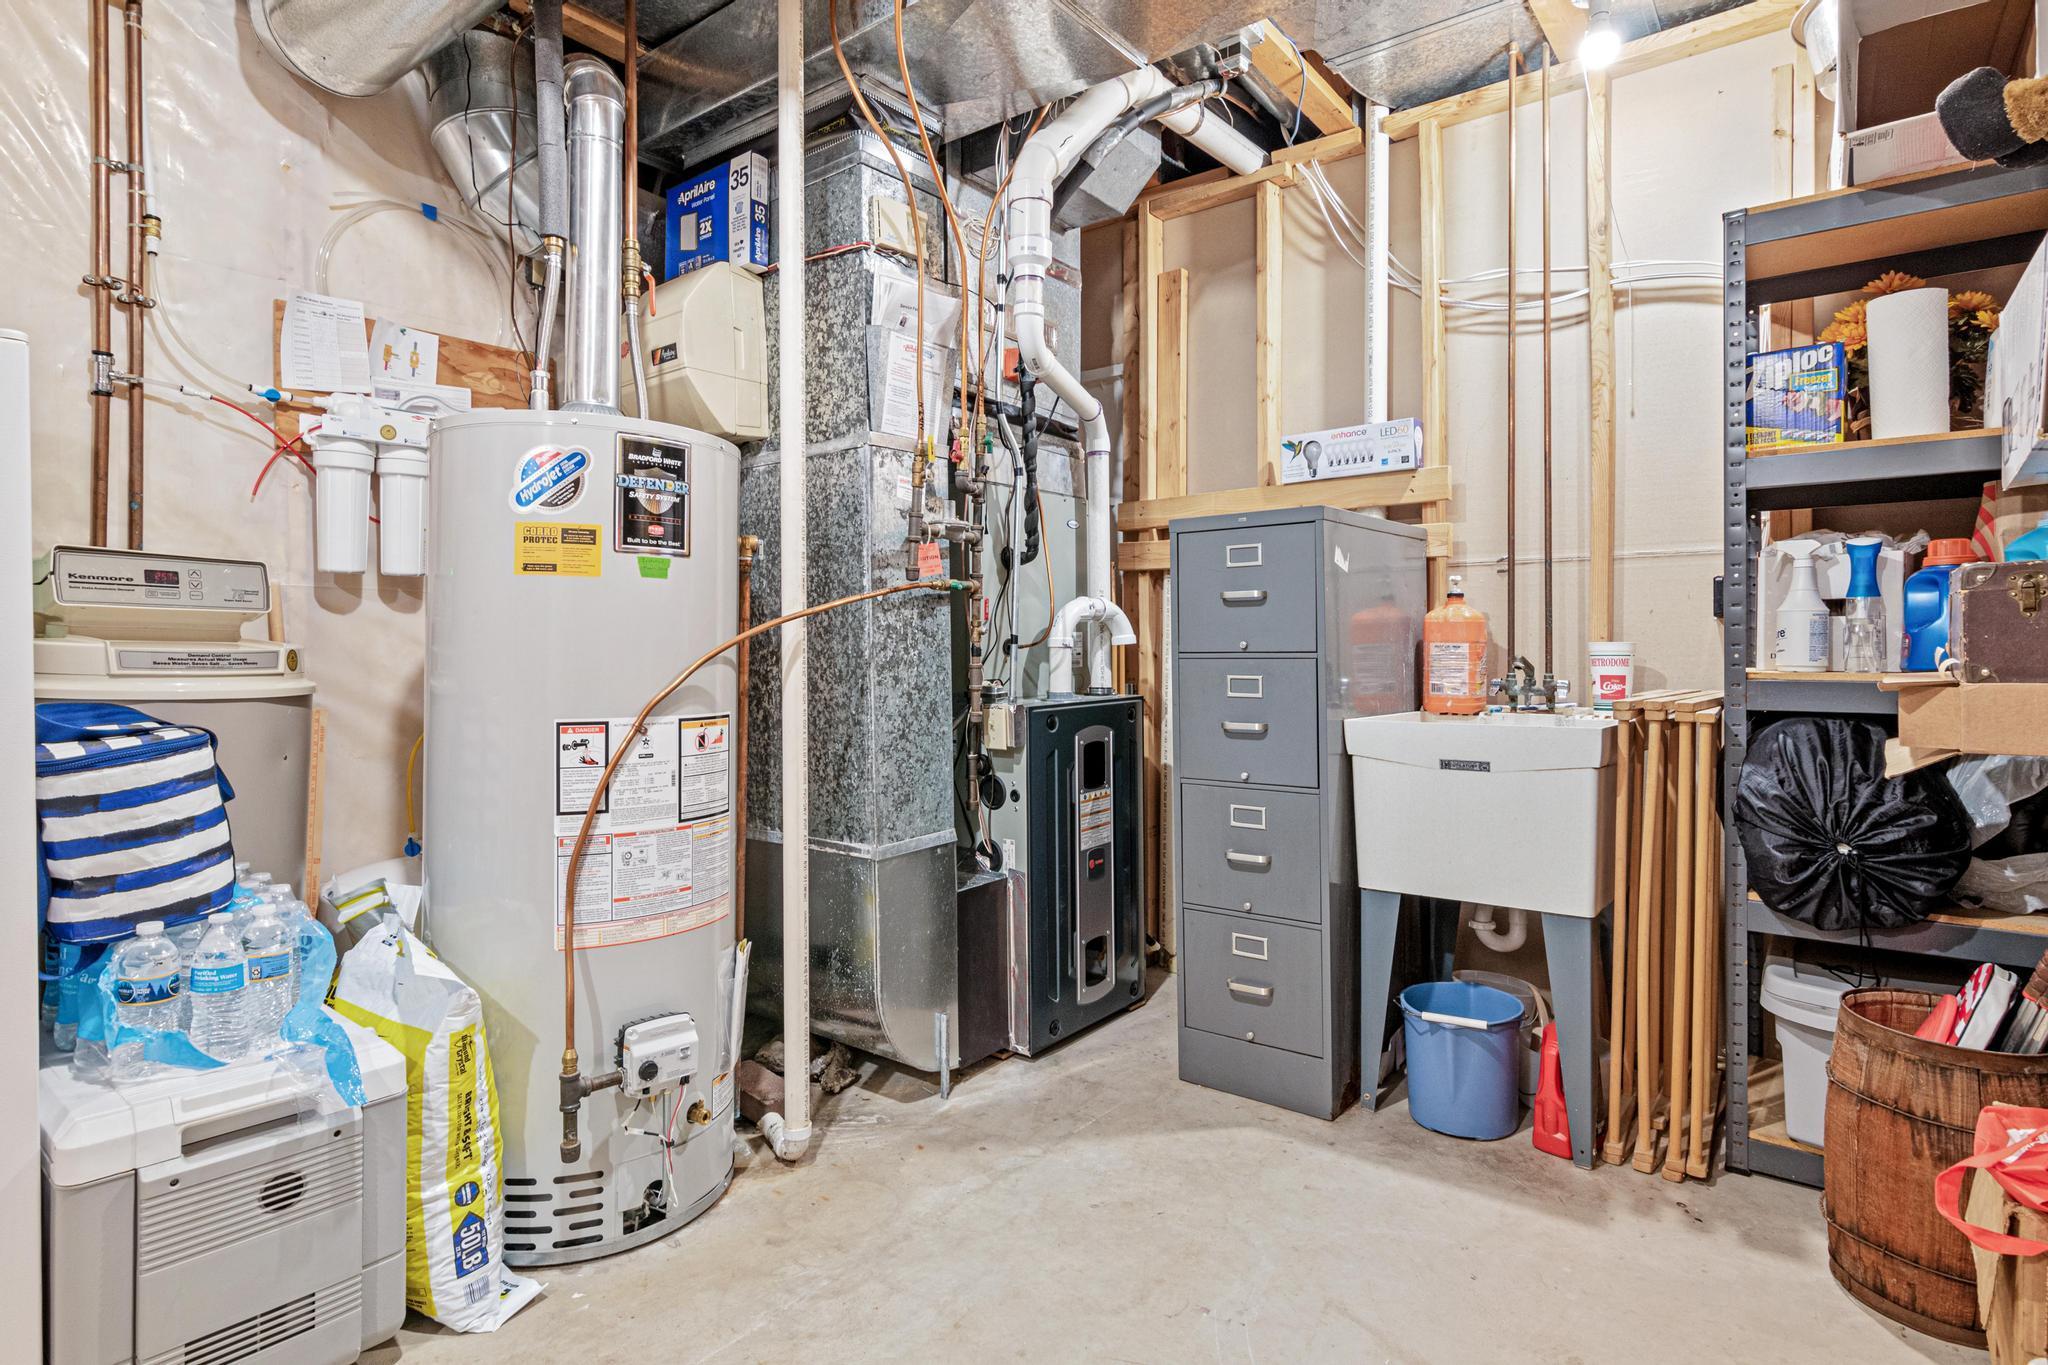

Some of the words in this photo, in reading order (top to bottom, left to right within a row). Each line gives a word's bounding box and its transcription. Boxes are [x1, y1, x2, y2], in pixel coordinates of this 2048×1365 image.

[730, 165, 749, 190] 35
[677, 179, 716, 206] AprilAire
[754, 204, 766, 224] 35
[700, 220, 712, 234] 2X
[1751, 345, 1834, 392] Ziploc
[1330, 429, 1367, 440] enhance
[628, 453, 662, 464] BRADFORD
[663, 458, 682, 466] WHITE
[617, 474, 689, 495] DEFENDER
[629, 491, 655, 499] SAFETY
[655, 494, 680, 503] SYSTEM
[522, 536, 558, 544] PROTEC
[68, 573, 134, 582] Kenmore
[1602, 682, 1623, 690] Coke
[462, 1034, 472, 1063] Diamond
[456, 1049, 467, 1075] Crystal
[464, 1090, 472, 1126] BRIGHT
